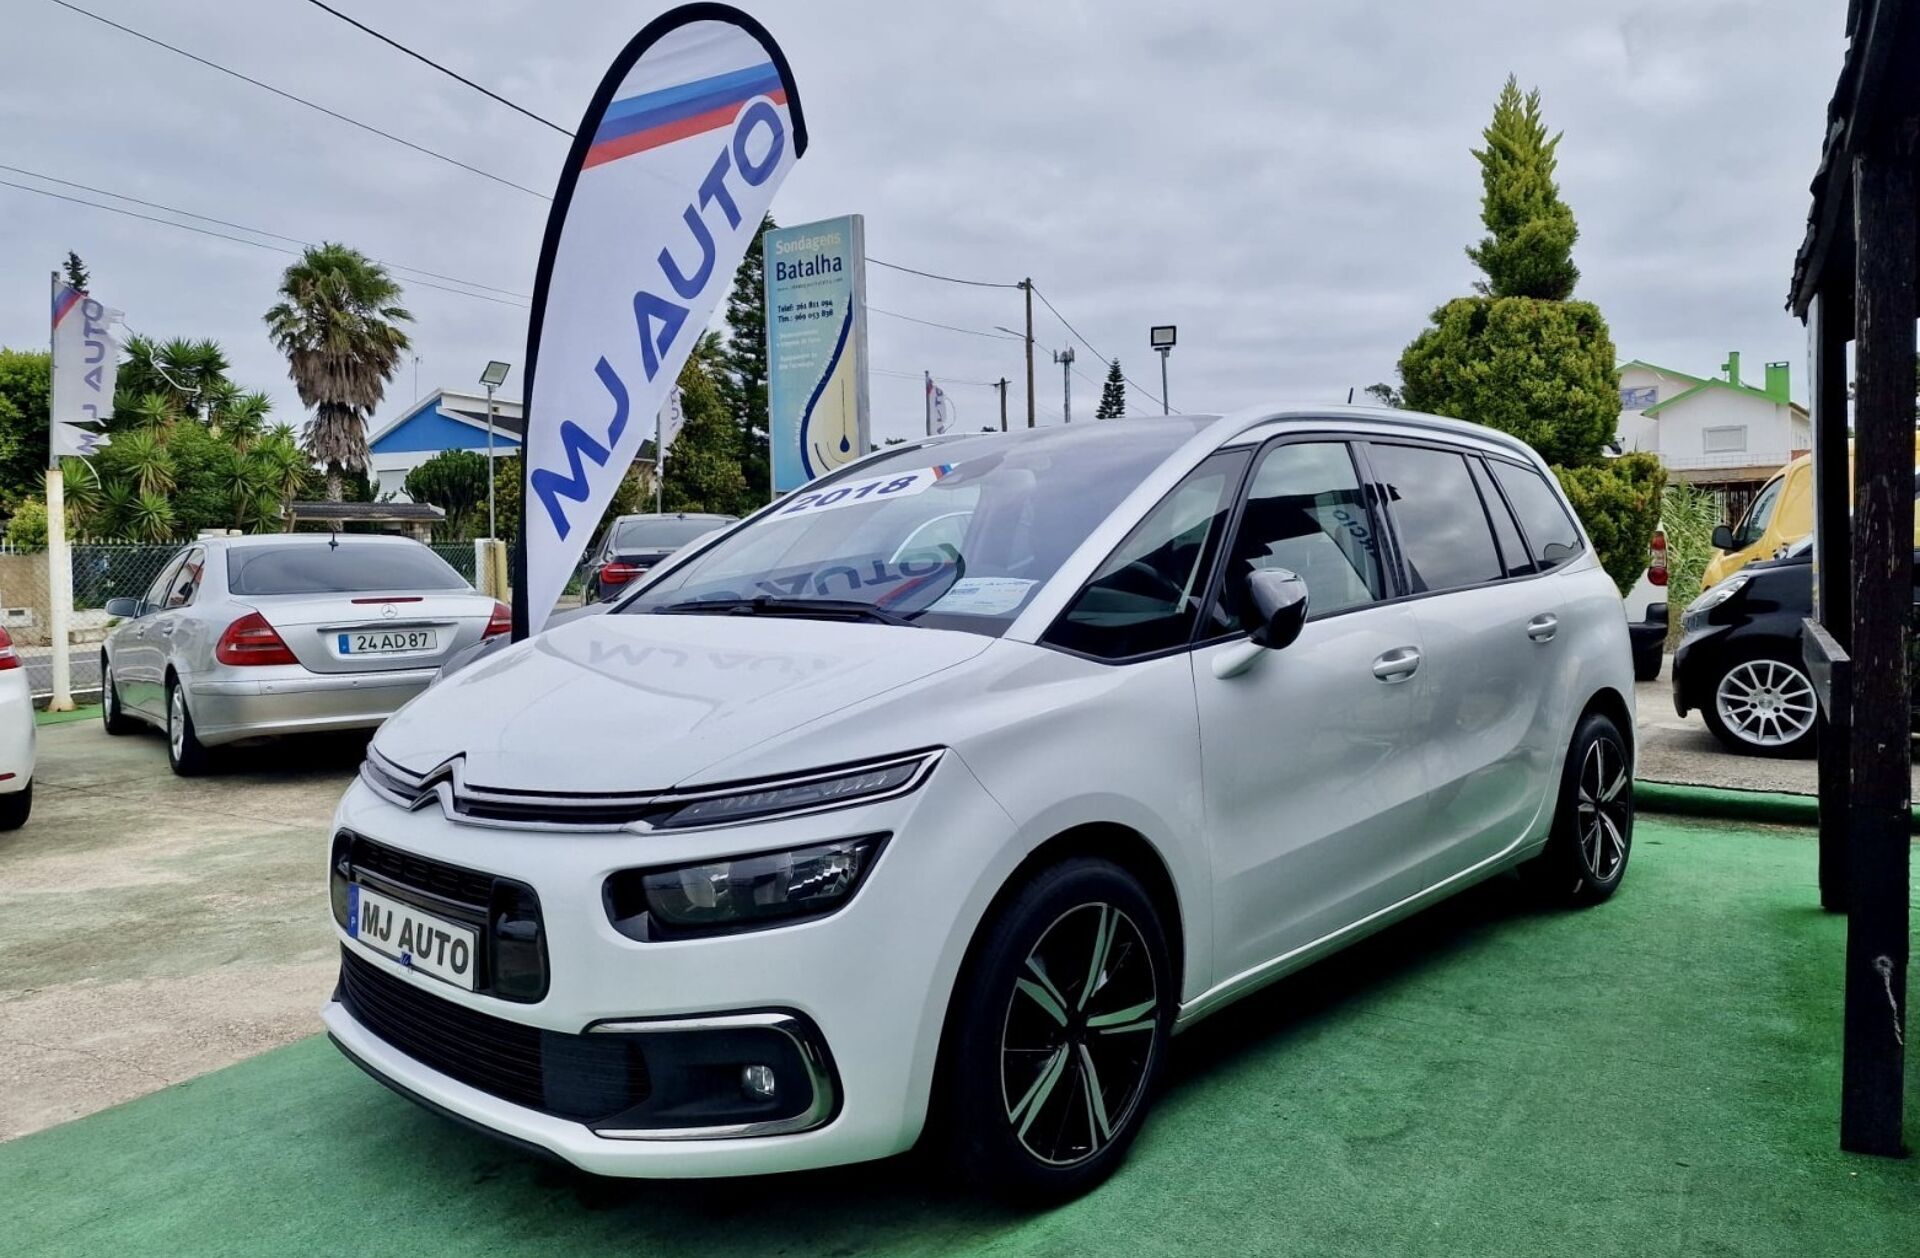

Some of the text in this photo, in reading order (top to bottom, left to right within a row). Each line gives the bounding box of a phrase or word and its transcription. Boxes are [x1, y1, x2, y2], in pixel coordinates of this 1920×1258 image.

[775, 231, 841, 255] Sondagens
[776, 252, 843, 282] Batalha
[531, 100, 785, 540] MJ AUTO
[81, 298, 108, 393] AUTO
[780, 474, 919, 516] 2018
[356, 632, 429, 651] 24 AD 87
[361, 900, 469, 976] MJ AUTO
